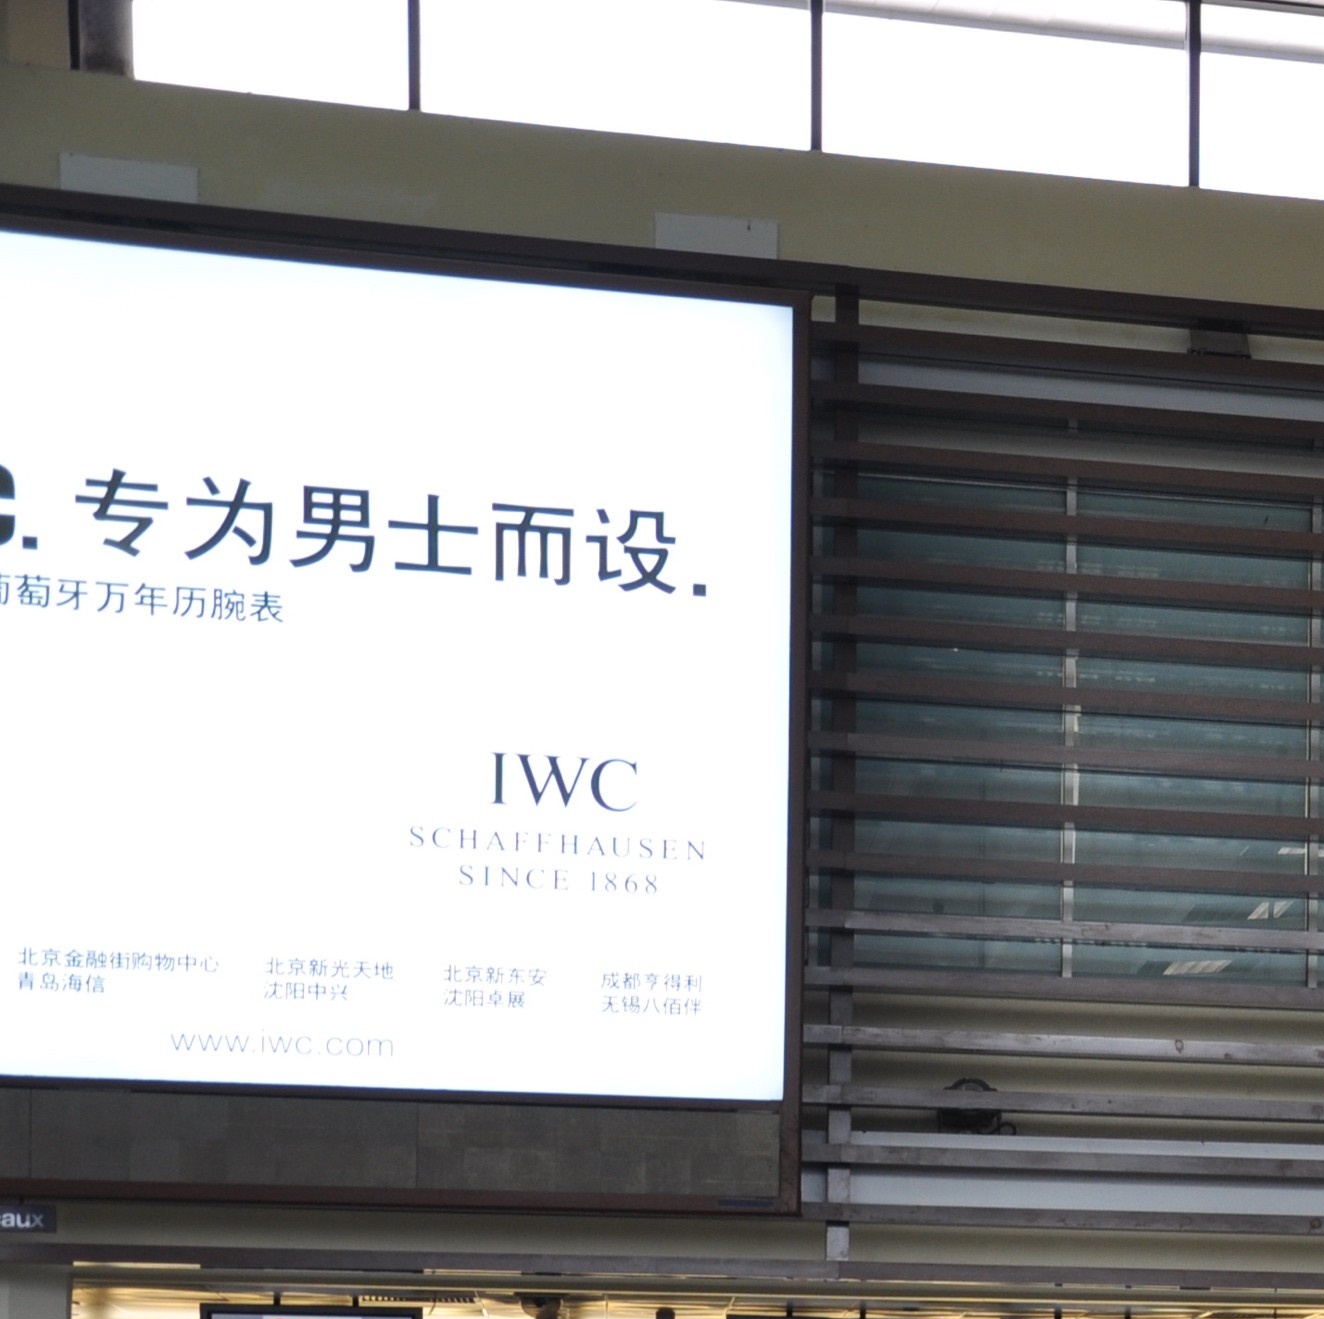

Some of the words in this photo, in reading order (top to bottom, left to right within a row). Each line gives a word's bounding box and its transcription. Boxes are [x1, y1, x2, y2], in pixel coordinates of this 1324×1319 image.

[490, 752, 638, 812] IWC
[409, 826, 705, 861] SCHAFFHAUSEN
[459, 864, 569, 890] SINCE
[591, 871, 658, 894] 1868
[18, 947, 220, 973] 北京金融街购物中心
[265, 957, 394, 980] 北京新光天地
[18, 971, 106, 994] 青岛海信
[444, 964, 547, 986] 北京新东安
[264, 981, 348, 1001] 沈阳中兴
[171, 1029, 393, 1057] www.iwc.com
[0, 1212, 45, 1228] aux
